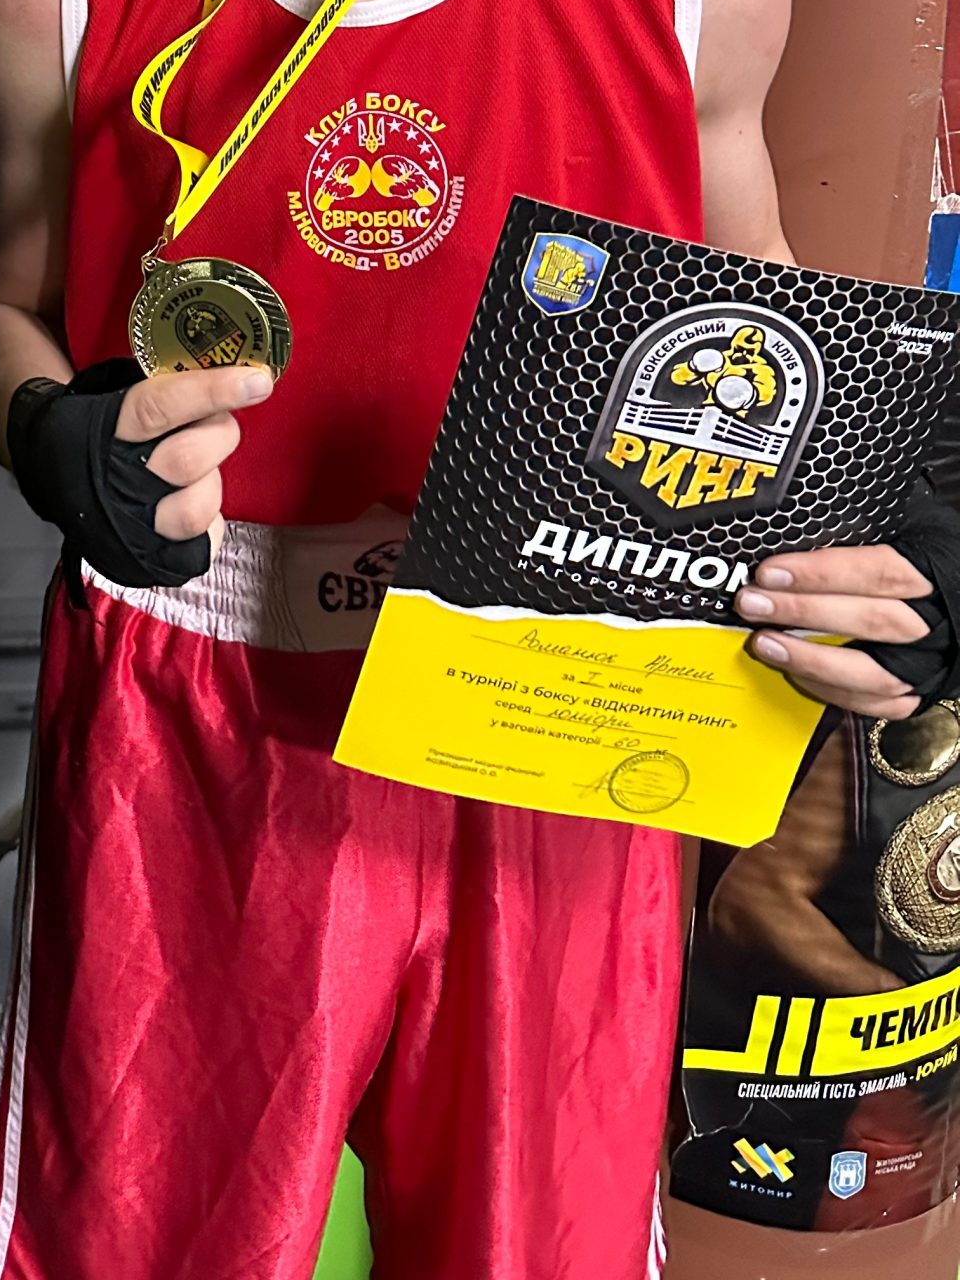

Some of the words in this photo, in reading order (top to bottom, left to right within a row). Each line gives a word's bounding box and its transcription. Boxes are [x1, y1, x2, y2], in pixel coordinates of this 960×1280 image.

[303, 97, 358, 148] КЛУБ
[365, 92, 447, 133] БОКСУ
[217, 125, 249, 178] РИНГ
[321, 206, 431, 231] ЄВРОБОКС
[344, 229, 405, 246] 2005
[888, 321, 955, 343] Житомир
[640, 319, 727, 382] БОКСЕРСЬКИЙ
[771, 339, 799, 372] КЛУБ
[897, 339, 933, 356] 2023
[604, 430, 778, 510] РИНГ
[561, 672, 576, 683] за
[608, 681, 644, 696] місце
[460, 670, 518, 693] турнірі
[520, 684, 529, 695] з
[533, 686, 580, 706] боксу
[583, 696, 685, 722] «ВІДКРИТИЙ
[687, 712, 738, 730] РИНГ»
[494, 699, 532, 715] серед
[501, 719, 545, 736] ваговій
[547, 728, 601, 746] категорії
[737, 1080, 821, 1100] СПЕЦІАЛЬНИЙ
[822, 1081, 856, 1099] ГІСТЬ
[858, 1071, 907, 1097] ЗМАГАНЬ
[915, 1043, 958, 1082] ЮРІЙ
[728, 1177, 793, 1200] ЖИТОМИР
